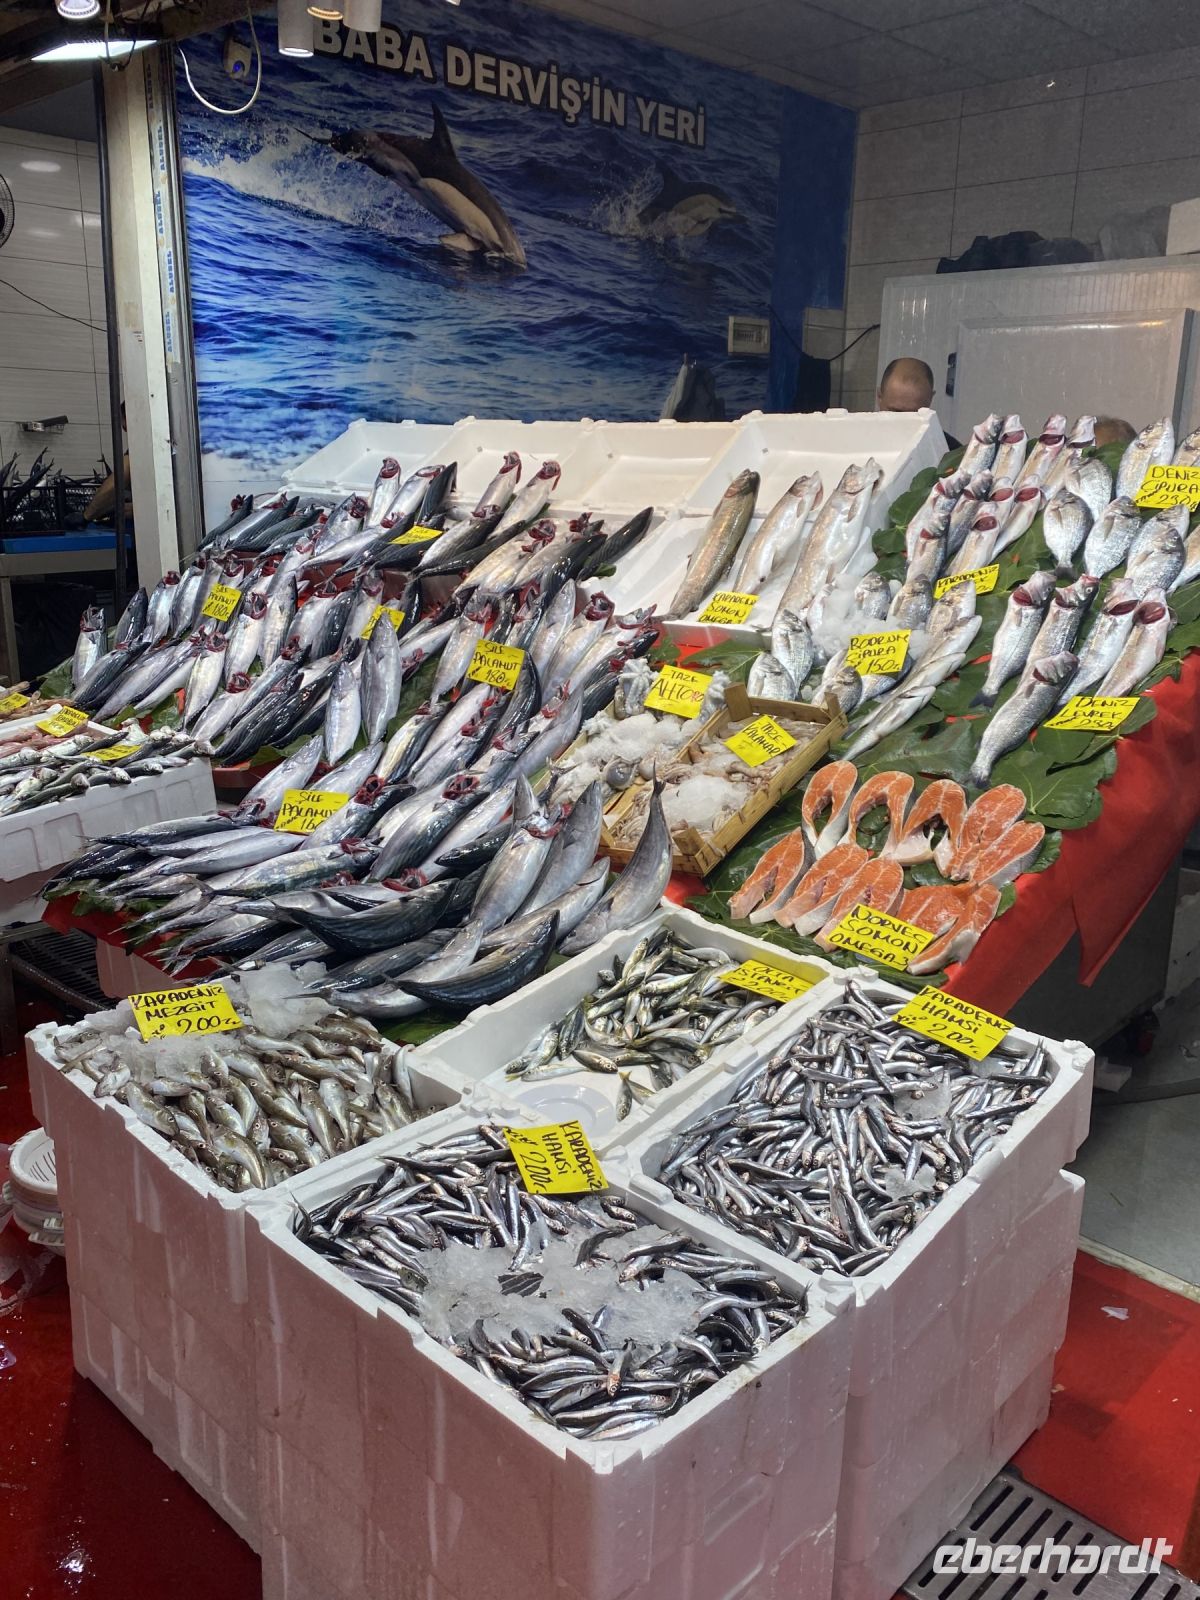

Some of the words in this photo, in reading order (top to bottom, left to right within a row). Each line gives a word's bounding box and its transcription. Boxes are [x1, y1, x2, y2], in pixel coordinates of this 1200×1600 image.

[313, 17, 434, 79] BABA
[636, 95, 706, 146] YERİ
[282, 803, 339, 818] PALAMU
[829, 933, 896, 963] OMEGA
[840, 919, 919, 954] SOMON
